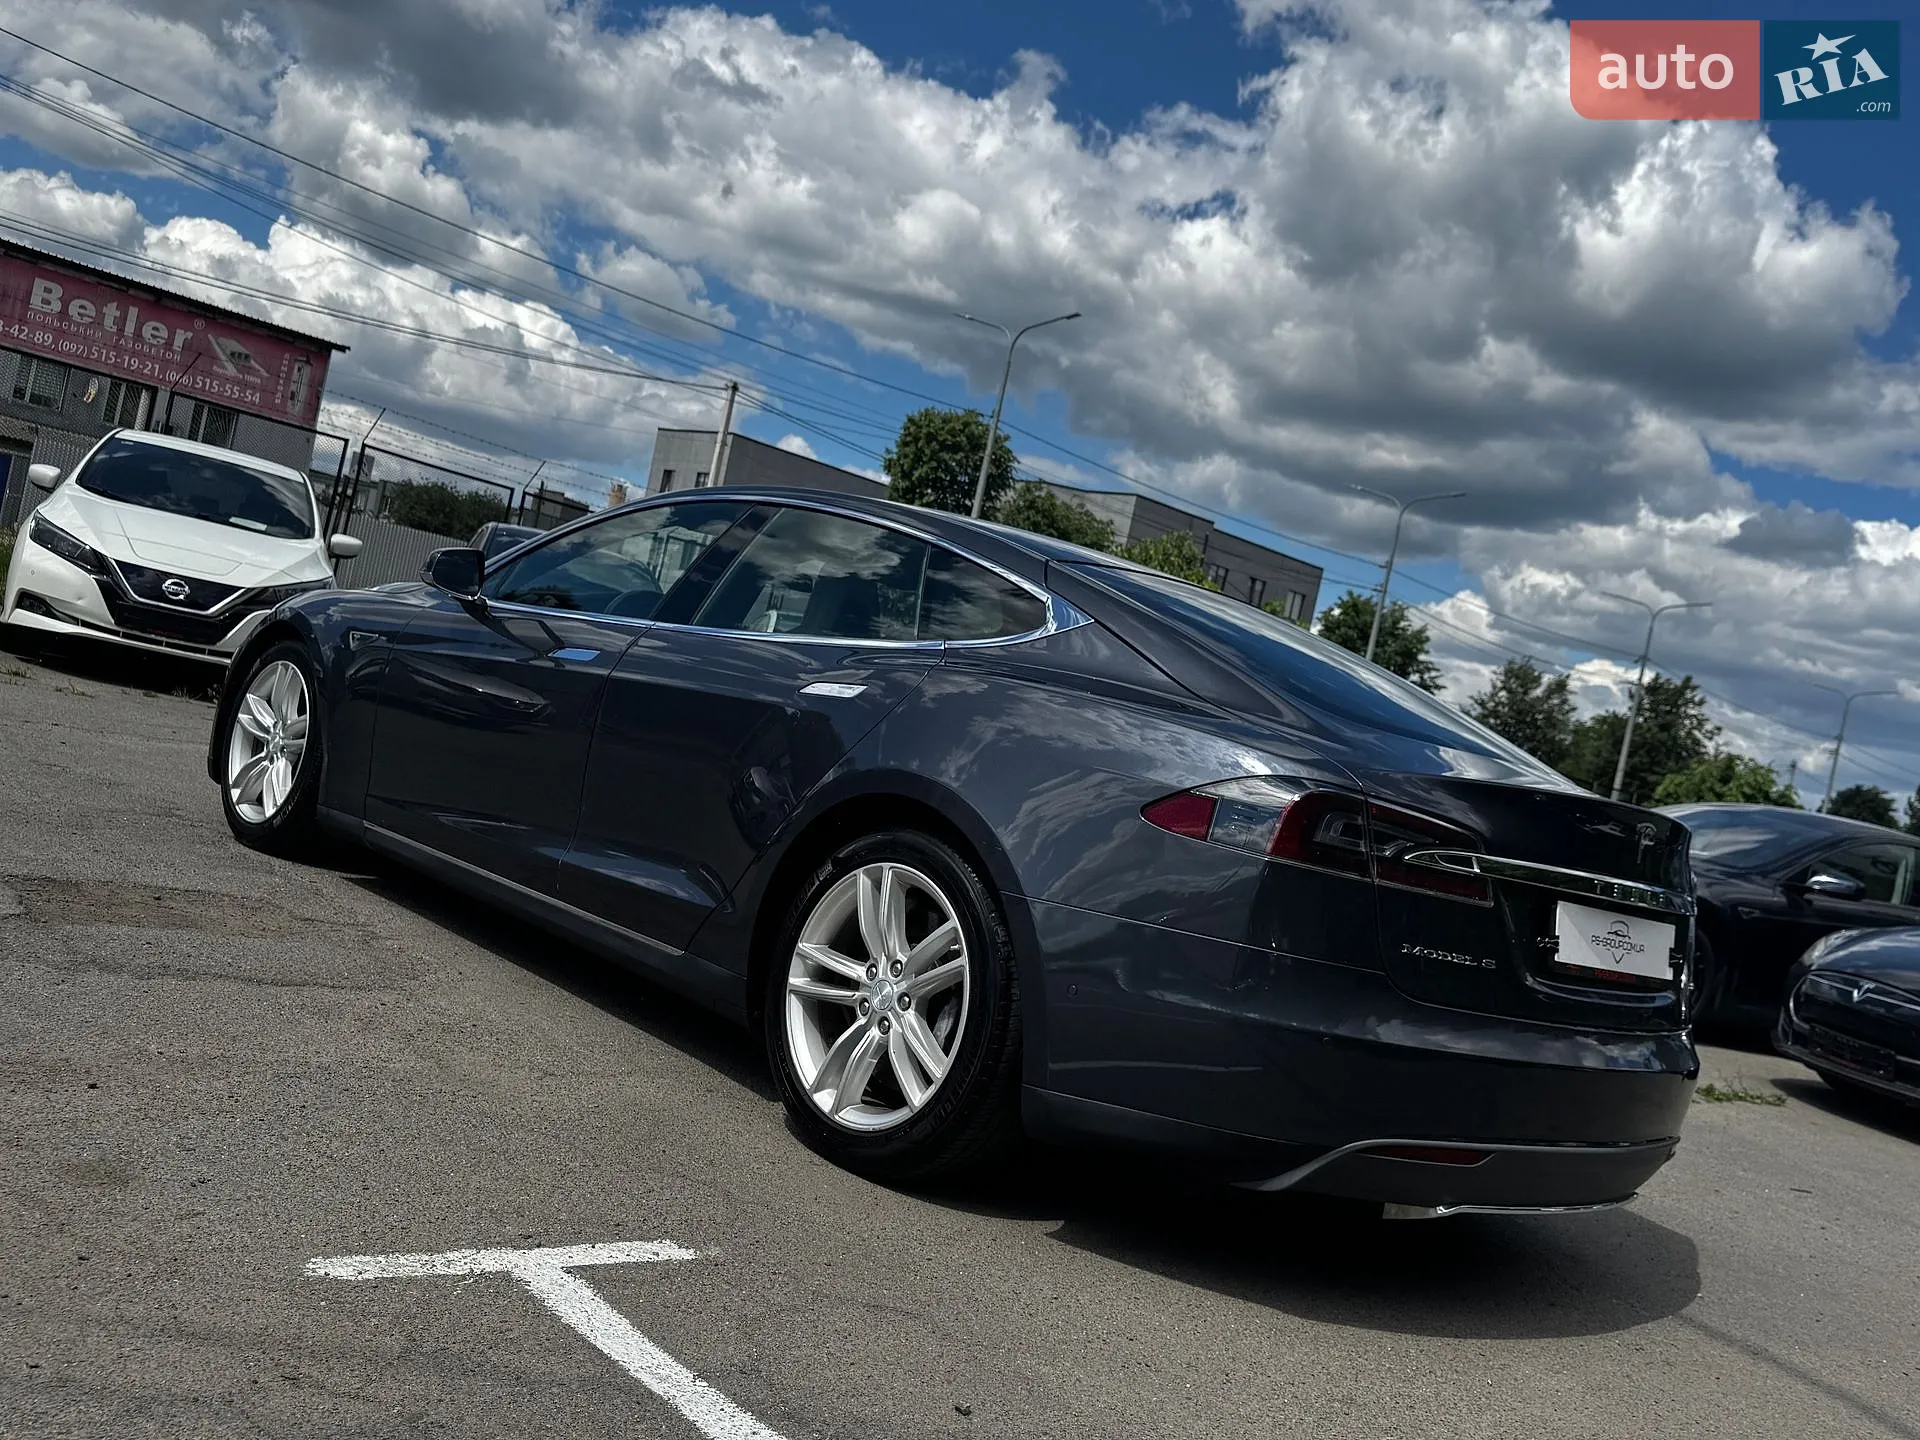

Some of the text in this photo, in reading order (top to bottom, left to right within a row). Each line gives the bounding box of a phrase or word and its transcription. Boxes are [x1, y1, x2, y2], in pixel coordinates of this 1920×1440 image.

[28, 277, 193, 352] Betler
[58, 339, 88, 358] (097)
[90, 345, 163, 379] 515-19-21,
[195, 376, 261, 405] 515-55-54
[1481, 957, 1497, 970] S
